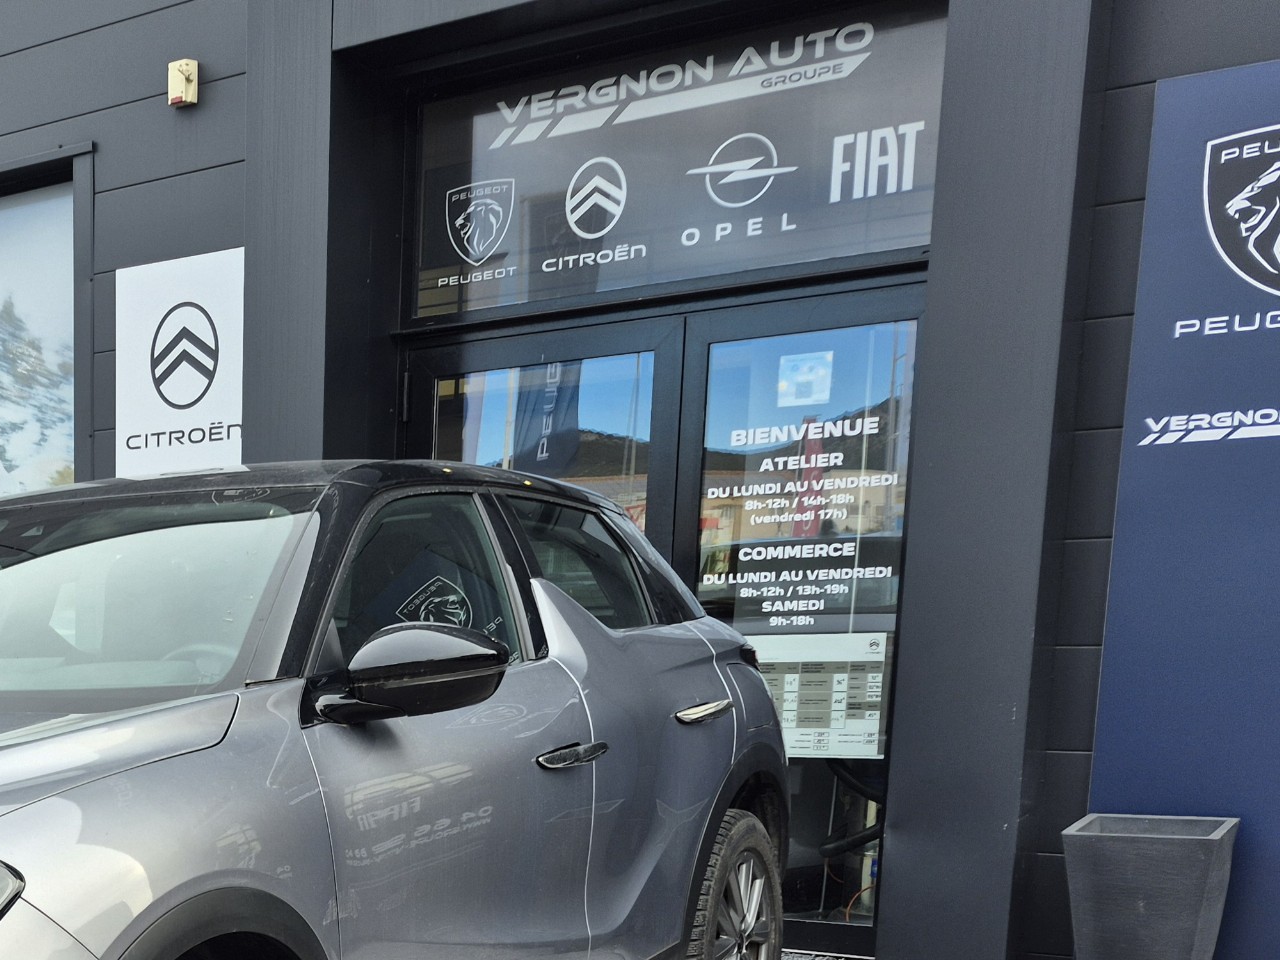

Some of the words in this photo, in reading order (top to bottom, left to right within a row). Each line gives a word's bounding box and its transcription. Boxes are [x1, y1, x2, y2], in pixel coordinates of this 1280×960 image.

[497, 55, 714, 124] VERGNON
[728, 22, 875, 78] AUTO
[760, 62, 845, 89] GROUPE
[829, 120, 925, 204] FIAT
[451, 184, 508, 203] PEUGEOT
[680, 212, 797, 246] OPEL
[541, 243, 647, 273] CITROËN
[438, 266, 517, 288] PEUGEOT
[1144, 408, 1280, 432] VERGNO
[125, 421, 243, 451] CITROËN
[731, 416, 880, 447] BIENVENUE
[758, 452, 844, 473] ATELIER
[707, 487, 730, 500] DU
[733, 483, 781, 497] LUNDI
[784, 480, 808, 494] AU
[811, 473, 898, 491] VENDREDI
[744, 498, 790, 511] 8h-12h
[801, 493, 855, 508] 14h-18h
[750, 510, 814, 526] (vendredi
[817, 508, 848, 522] 17h)
[738, 542, 856, 561] COMMERCE
[702, 573, 726, 586] DU
[728, 571, 776, 584] LUNDI
[779, 570, 803, 582] AU
[806, 566, 892, 581] VENDREDI
[739, 585, 785, 598] 8h-12h
[796, 583, 849, 596] 13h-19h
[761, 599, 825, 613] SAMEDI
[769, 615, 814, 627] 9h-18h
